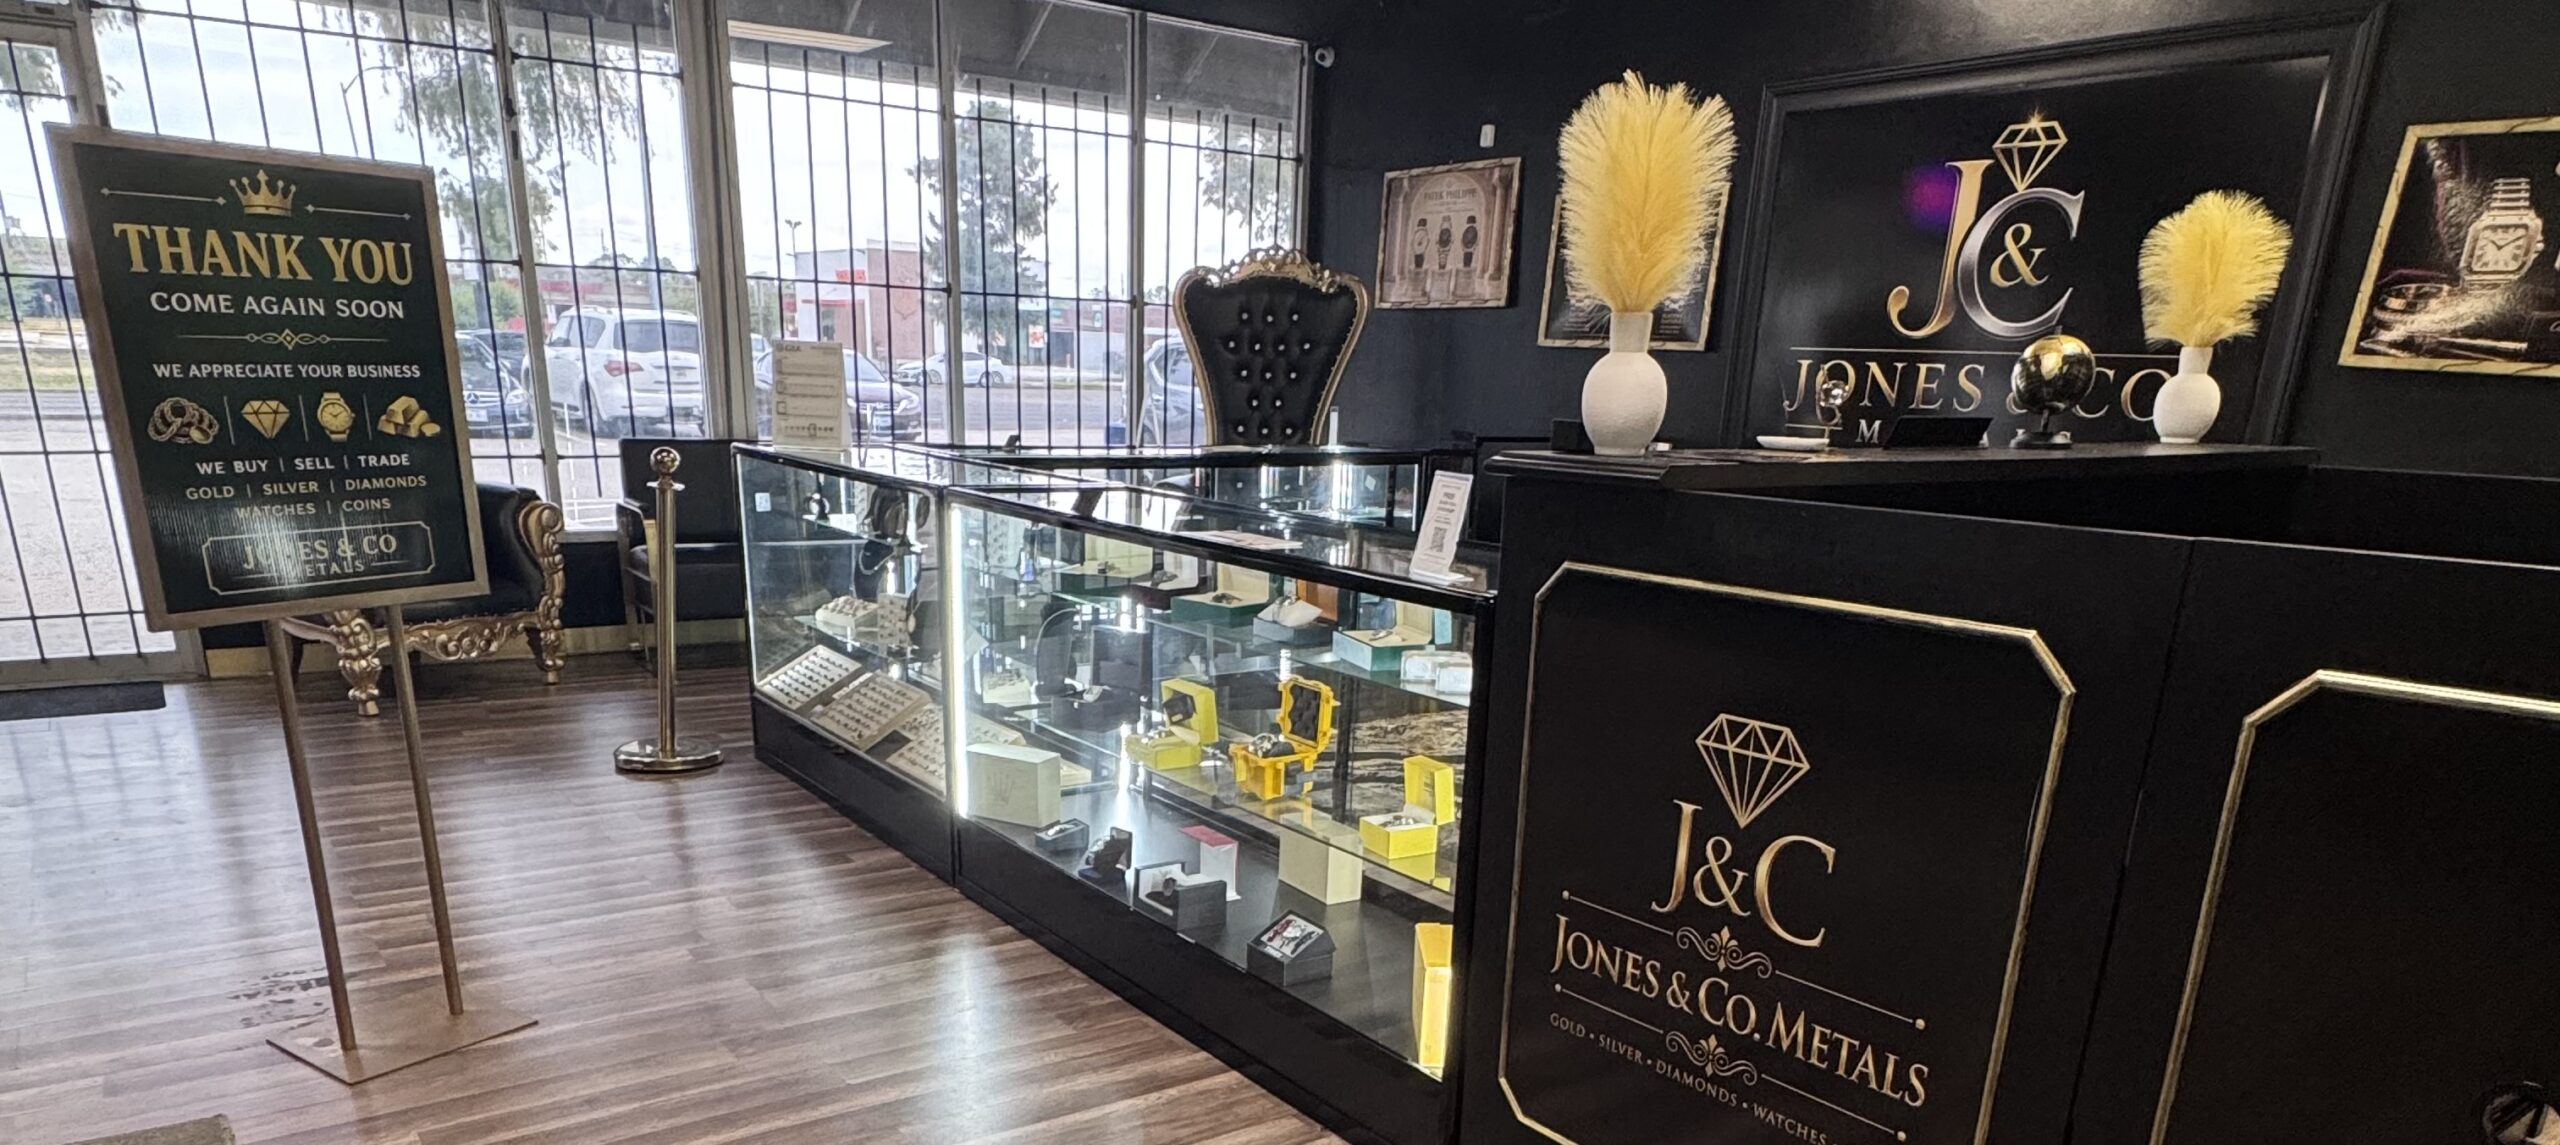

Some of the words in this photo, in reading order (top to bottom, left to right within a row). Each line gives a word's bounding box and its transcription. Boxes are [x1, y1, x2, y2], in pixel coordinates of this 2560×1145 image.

[113, 222, 312, 281] THANK
[319, 237, 413, 286] YOU
[150, 291, 234, 314] COME
[243, 296, 325, 316] AGAIN
[336, 299, 404, 319] SOON
[153, 364, 182, 378] WE
[189, 364, 293, 378] APPRECIATE
[298, 364, 343, 378] YOUR
[347, 364, 420, 378] BUSINESS
[1782, 360, 1985, 412] JONES
[196, 461, 226, 475] WE
[233, 460, 268, 473] BUY
[294, 457, 335, 470] SELL
[358, 454, 410, 467] TRADE
[185, 486, 235, 500] GOLD
[262, 481, 319, 496] SILVER
[345, 475, 427, 491] DIAMONDS
[235, 502, 316, 519] WATCHES
[342, 498, 391, 512] COINS
[337, 537, 355, 557] &
[362, 534, 397, 555] CO
[1651, 799, 1836, 948] J&C
[1550, 914, 1661, 998] JONES
[1666, 971, 1694, 1016] &
[1765, 1002, 1929, 1108] METALS
[1550, 1012, 1585, 1039] GOLD
[1598, 1033, 1643, 1065] SILVER
[1655, 1058, 1737, 1107] DIAMONDS
[1753, 1103, 1827, 1145] WATCHES
